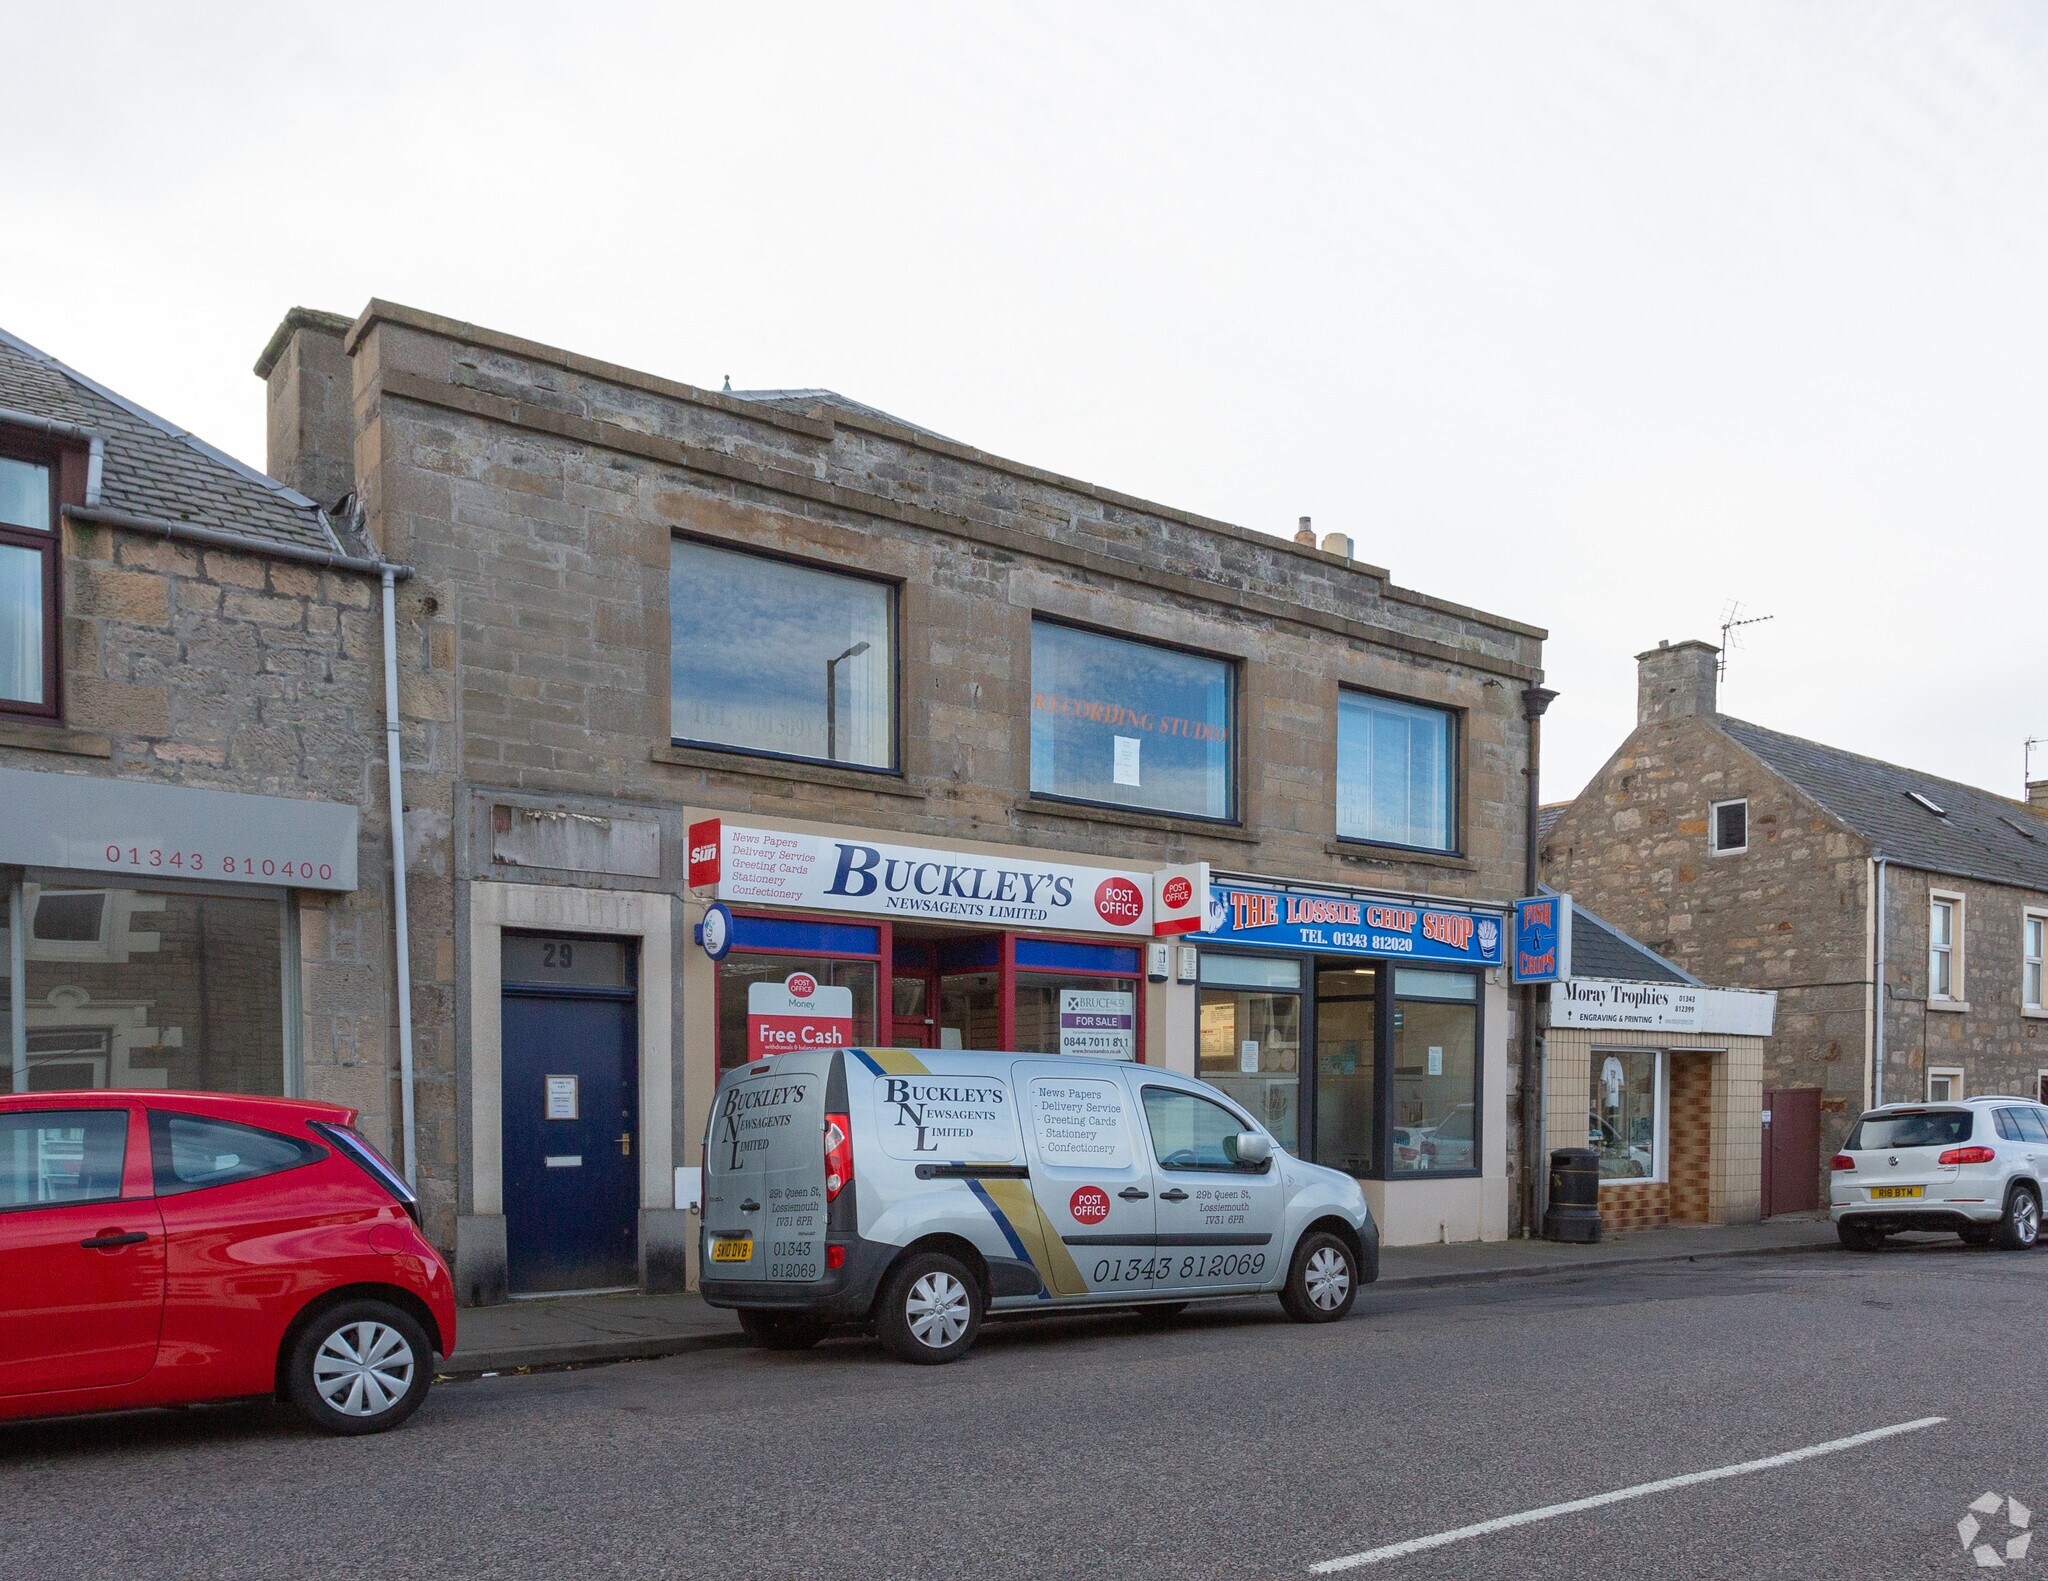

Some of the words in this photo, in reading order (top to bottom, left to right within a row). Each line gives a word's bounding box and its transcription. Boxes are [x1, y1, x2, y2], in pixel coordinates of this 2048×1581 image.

[1032, 691, 1155, 731] RECORDING
[1158, 715, 1228, 744] STUDIO
[732, 832, 760, 844] News
[763, 835, 798, 849] Papers
[690, 846, 717, 864] Sun
[732, 845, 776, 860] Delivery
[779, 850, 816, 863] Service
[106, 845, 204, 871] 01343
[222, 856, 333, 881] 810400
[732, 859, 776, 873] Greeting
[779, 863, 808, 875] Cards
[732, 872, 786, 887] Stationery
[823, 843, 1074, 907] BUCKLEY'S
[732, 885, 803, 901] Confectionery
[1106, 888, 1133, 902] POST
[1169, 882, 1187, 893] POST
[1165, 891, 1189, 903] OFFICE
[885, 896, 983, 916] NEWSAGENTS
[989, 905, 1048, 921] LIMITED
[1100, 901, 1139, 916] OFFICE
[1230, 891, 1278, 931] THE
[1286, 896, 1360, 925] LOSSIE
[1367, 906, 1417, 934] CHIP
[1422, 911, 1474, 951] SHOP
[1523, 902, 1552, 932] FISH
[1300, 928, 1328, 944] TEL.
[1332, 931, 1368, 948] 01343
[1372, 935, 1413, 952] 812020
[543, 943, 572, 969] 29
[1518, 946, 1555, 975] CHIPS
[790, 985, 812, 993] OFFICE
[1563, 982, 1608, 1007] Moray
[1611, 985, 1669, 1009] Trophies
[788, 999, 816, 1011] Money
[1679, 995, 1696, 1003] 01343
[1675, 1005, 1695, 1013] 812399
[1076, 1016, 1094, 1026] FOR
[1095, 1017, 1118, 1027] SALE
[1580, 1013, 1618, 1023] ENGRAVING
[1624, 1015, 1653, 1024] PRINTING
[760, 1024, 796, 1043] Free
[801, 1025, 842, 1044] Cash
[1064, 1037, 1086, 1047] 0844
[1089, 1037, 1110, 1047] 7011
[1112, 1037, 1128, 1047] 811
[883, 1078, 1003, 1104] BUCKLEY'S
[1039, 1087, 1065, 1098] News
[1069, 1089, 1102, 1100] Papers
[721, 1085, 806, 1118] BUCKLEY'S
[1041, 1101, 1083, 1113] Delivery
[1086, 1103, 1121, 1113] Service
[894, 1102, 996, 1126] NEWSAGENTS
[1043, 1114, 1086, 1127] Greeting
[1089, 1116, 1117, 1126] Cards
[721, 1113, 792, 1144] NEWSAGENTS
[1046, 1128, 1097, 1141] Stationery
[913, 1125, 974, 1151] LIMITED
[729, 1138, 770, 1171] LIMITED
[1048, 1142, 1116, 1155] Confectionery
[769, 1188, 783, 1199] 29b
[784, 1188, 808, 1199] Queen
[810, 1186, 821, 1197] St,
[1078, 1194, 1101, 1205] POST
[1196, 1190, 1212, 1199] 29b
[1214, 1190, 1238, 1200] Queen
[1240, 1190, 1251, 1200] St,
[1895, 1188, 1913, 1197] BTM
[771, 1201, 819, 1213] Lossiemouth
[1074, 1205, 1106, 1216] OFFICE
[1199, 1202, 1250, 1212] Lossiemouth
[776, 1217, 793, 1227] IV31
[796, 1216, 813, 1226] 6PR
[1205, 1216, 1224, 1225] IV31
[1228, 1215, 1245, 1224] 6PR
[773, 1241, 811, 1256] 01343
[771, 1263, 816, 1278] 812069
[1093, 1257, 1173, 1282] 01343
[1179, 1253, 1266, 1279] 812069
